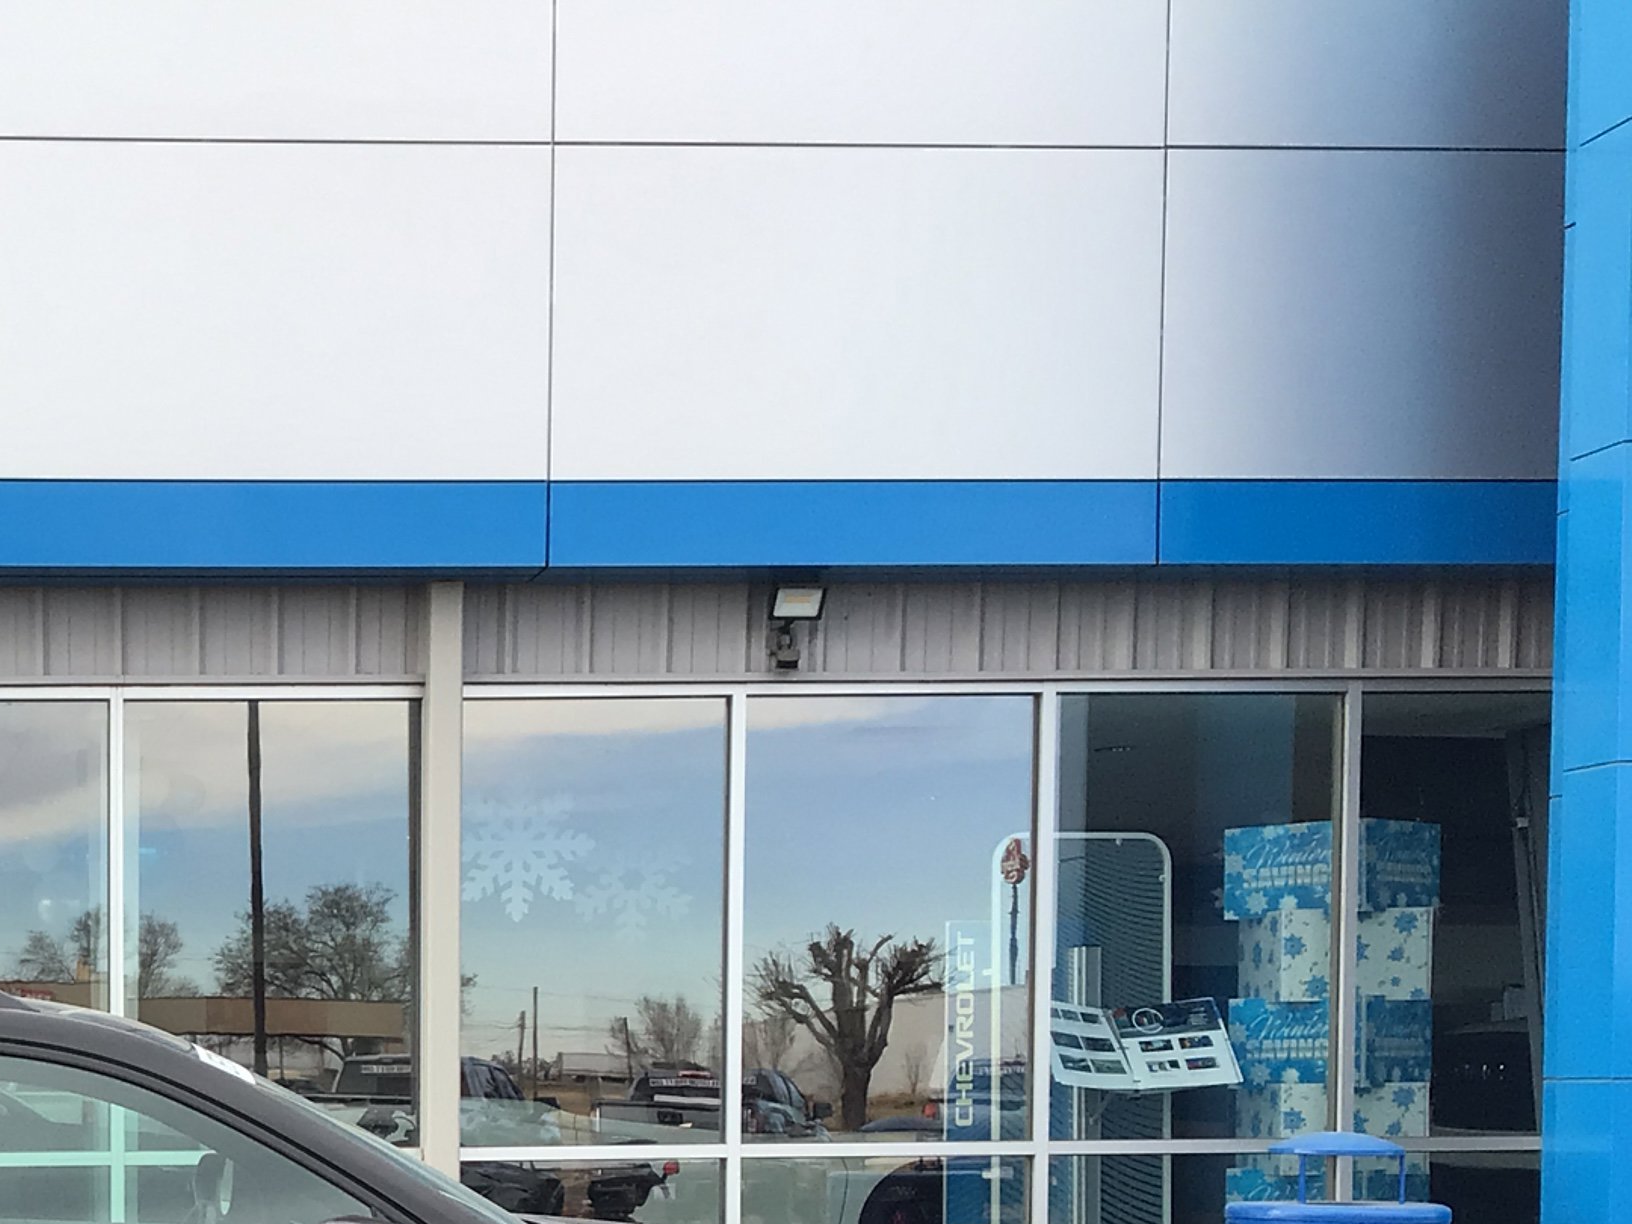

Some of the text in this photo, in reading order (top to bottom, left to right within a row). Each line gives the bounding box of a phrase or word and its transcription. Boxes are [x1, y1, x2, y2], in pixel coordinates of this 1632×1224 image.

[1243, 863, 1331, 889] SAVING
[955, 930, 975, 1127] CHEVROLET
[1246, 1038, 1329, 1060] SAVING
